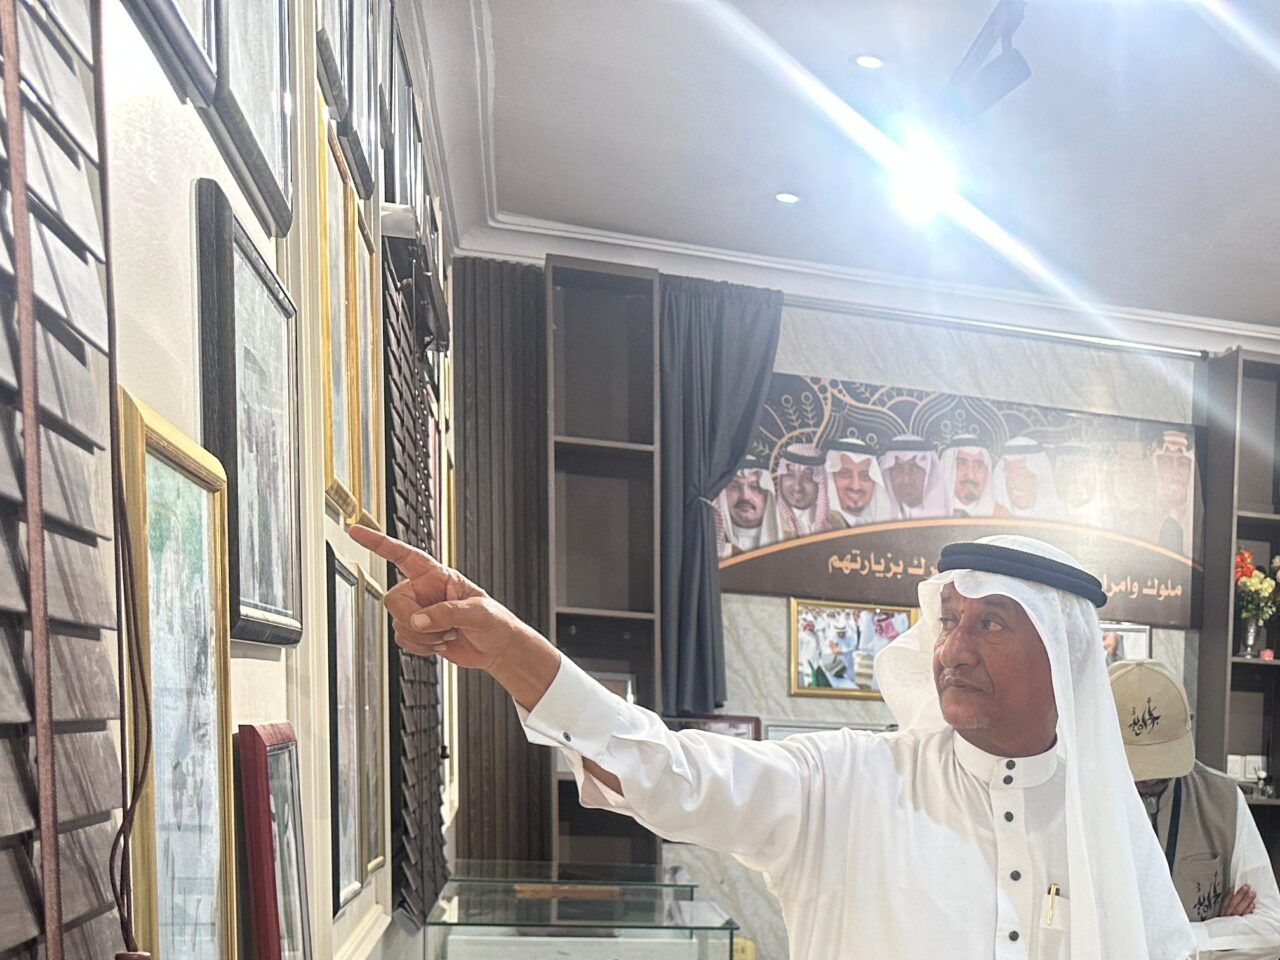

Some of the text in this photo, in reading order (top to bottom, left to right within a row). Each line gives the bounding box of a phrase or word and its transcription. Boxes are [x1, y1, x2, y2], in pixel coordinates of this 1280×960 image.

[828, 549, 904, 579] بزيارتهم
[1102, 573, 1139, 600] وامرا
[1142, 578, 1183, 601] ملوك
